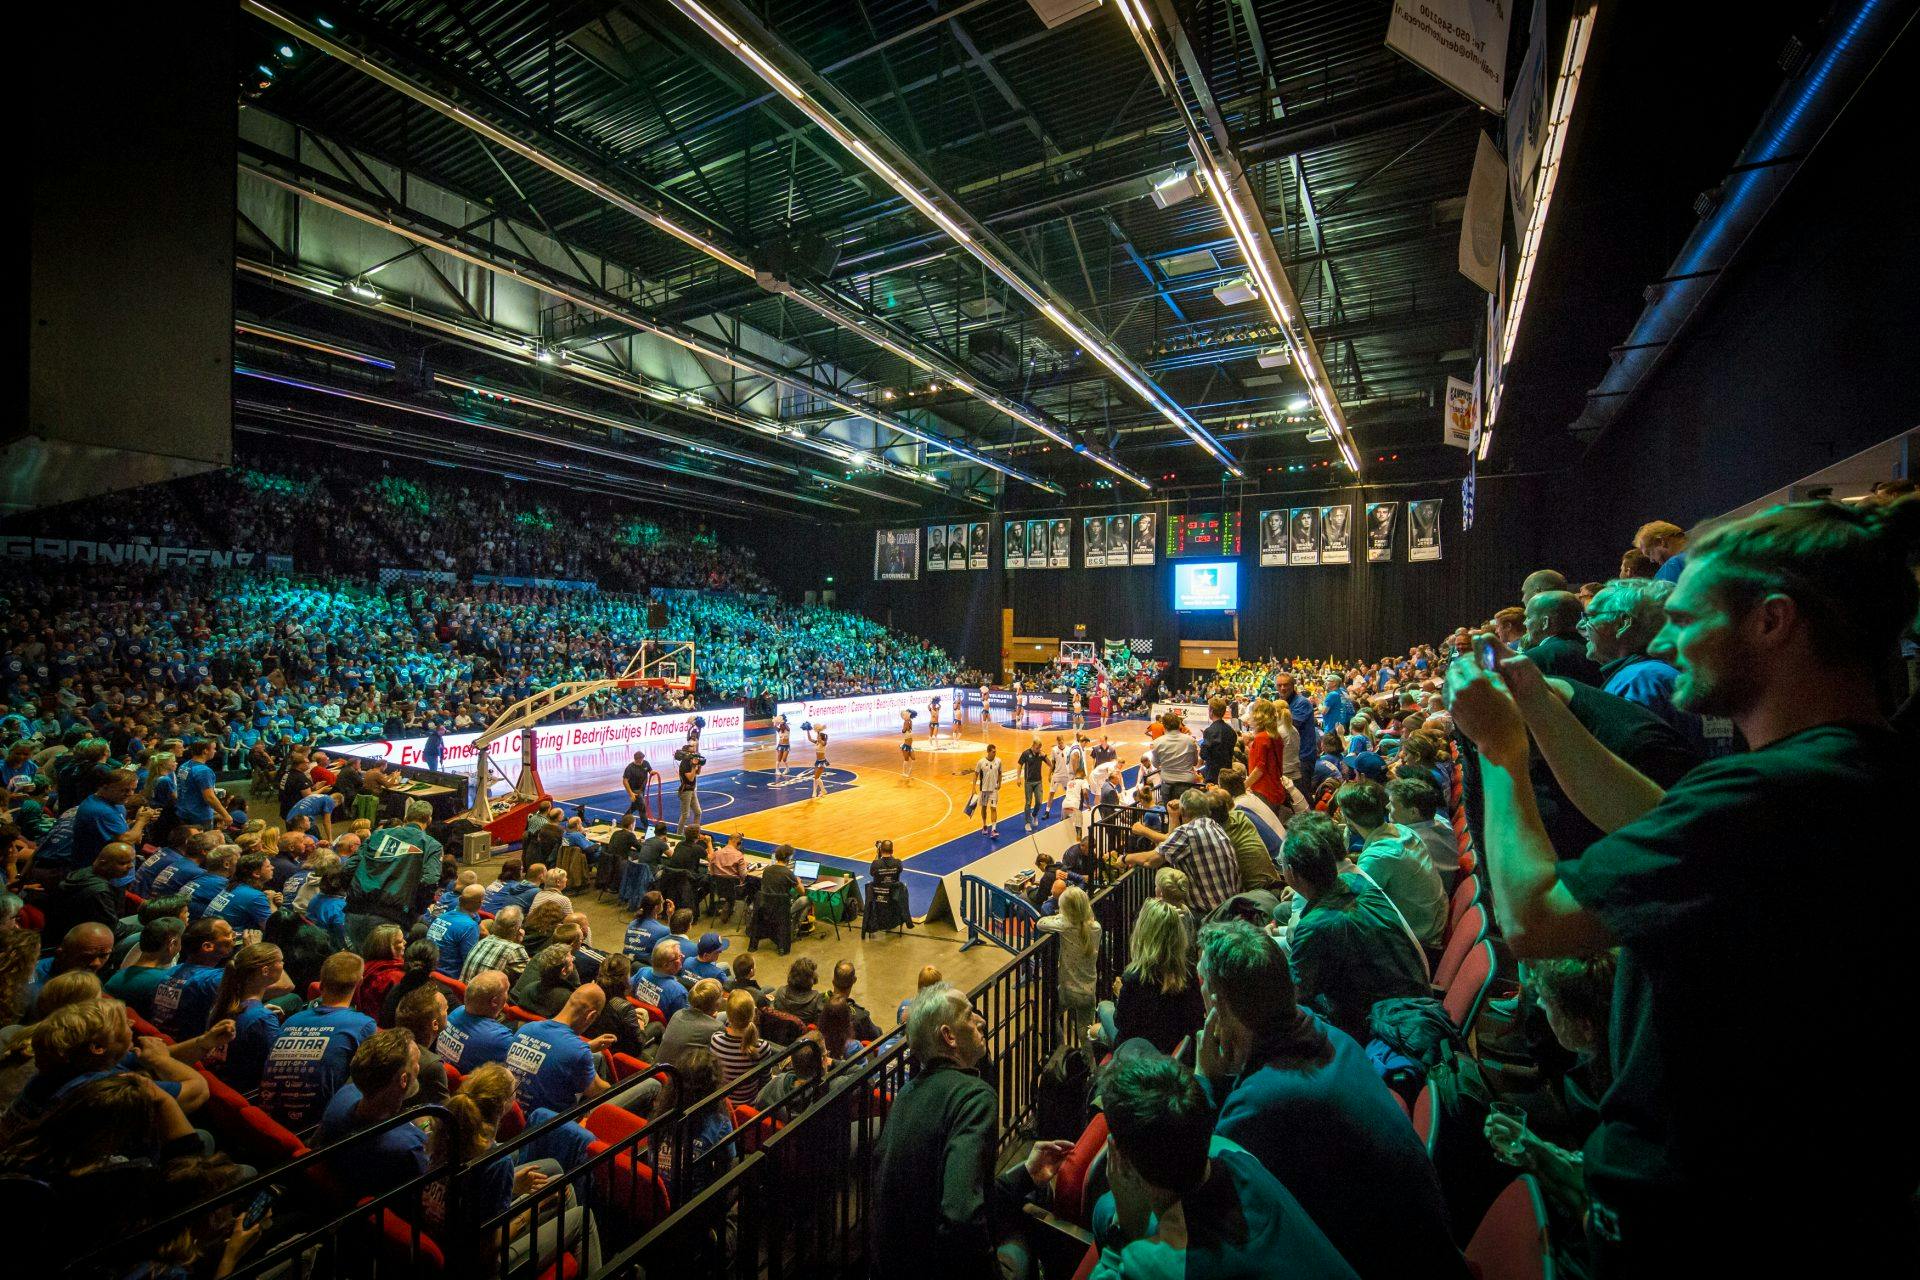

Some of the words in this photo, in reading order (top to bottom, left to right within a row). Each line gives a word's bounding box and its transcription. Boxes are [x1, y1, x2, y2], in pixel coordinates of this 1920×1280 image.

[808, 704, 847, 717] Evenementen
[851, 701, 873, 713] Catering
[513, 728, 563, 753] Cering
[573, 722, 642, 747] Bedrijfsuitjes
[712, 714, 740, 728] Horeca
[276, 1039, 324, 1050] DONAR
[510, 1044, 543, 1065] DONAR
